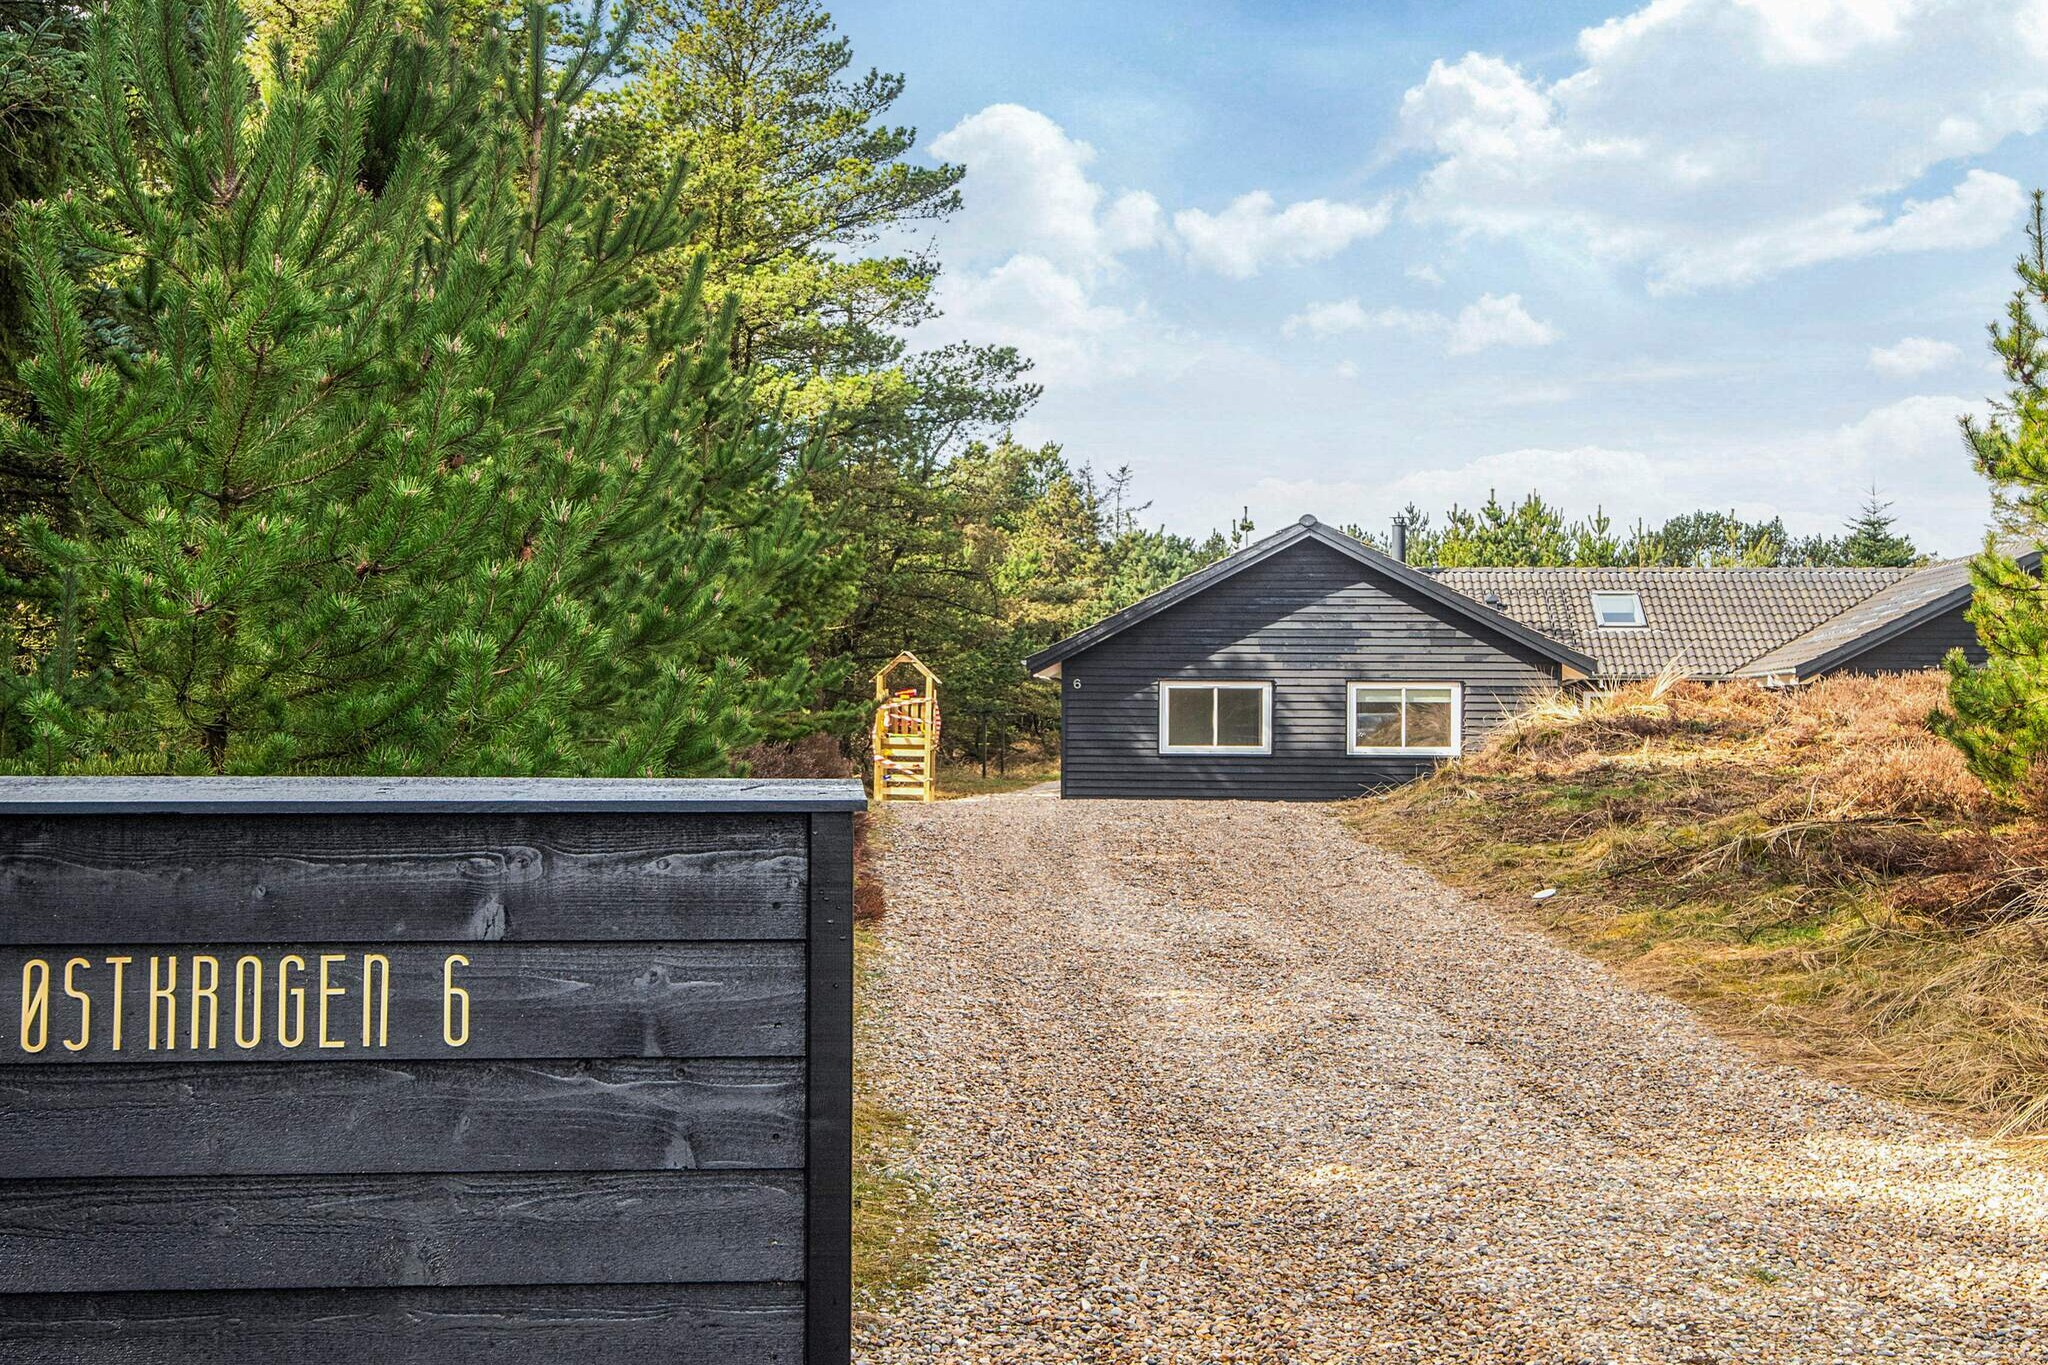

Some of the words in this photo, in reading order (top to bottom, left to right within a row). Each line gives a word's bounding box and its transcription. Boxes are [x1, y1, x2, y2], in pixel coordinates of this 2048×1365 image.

[1073, 678, 1082, 689] 6
[20, 953, 391, 1053] ØSTKROGEN
[443, 953, 471, 1048] 6
